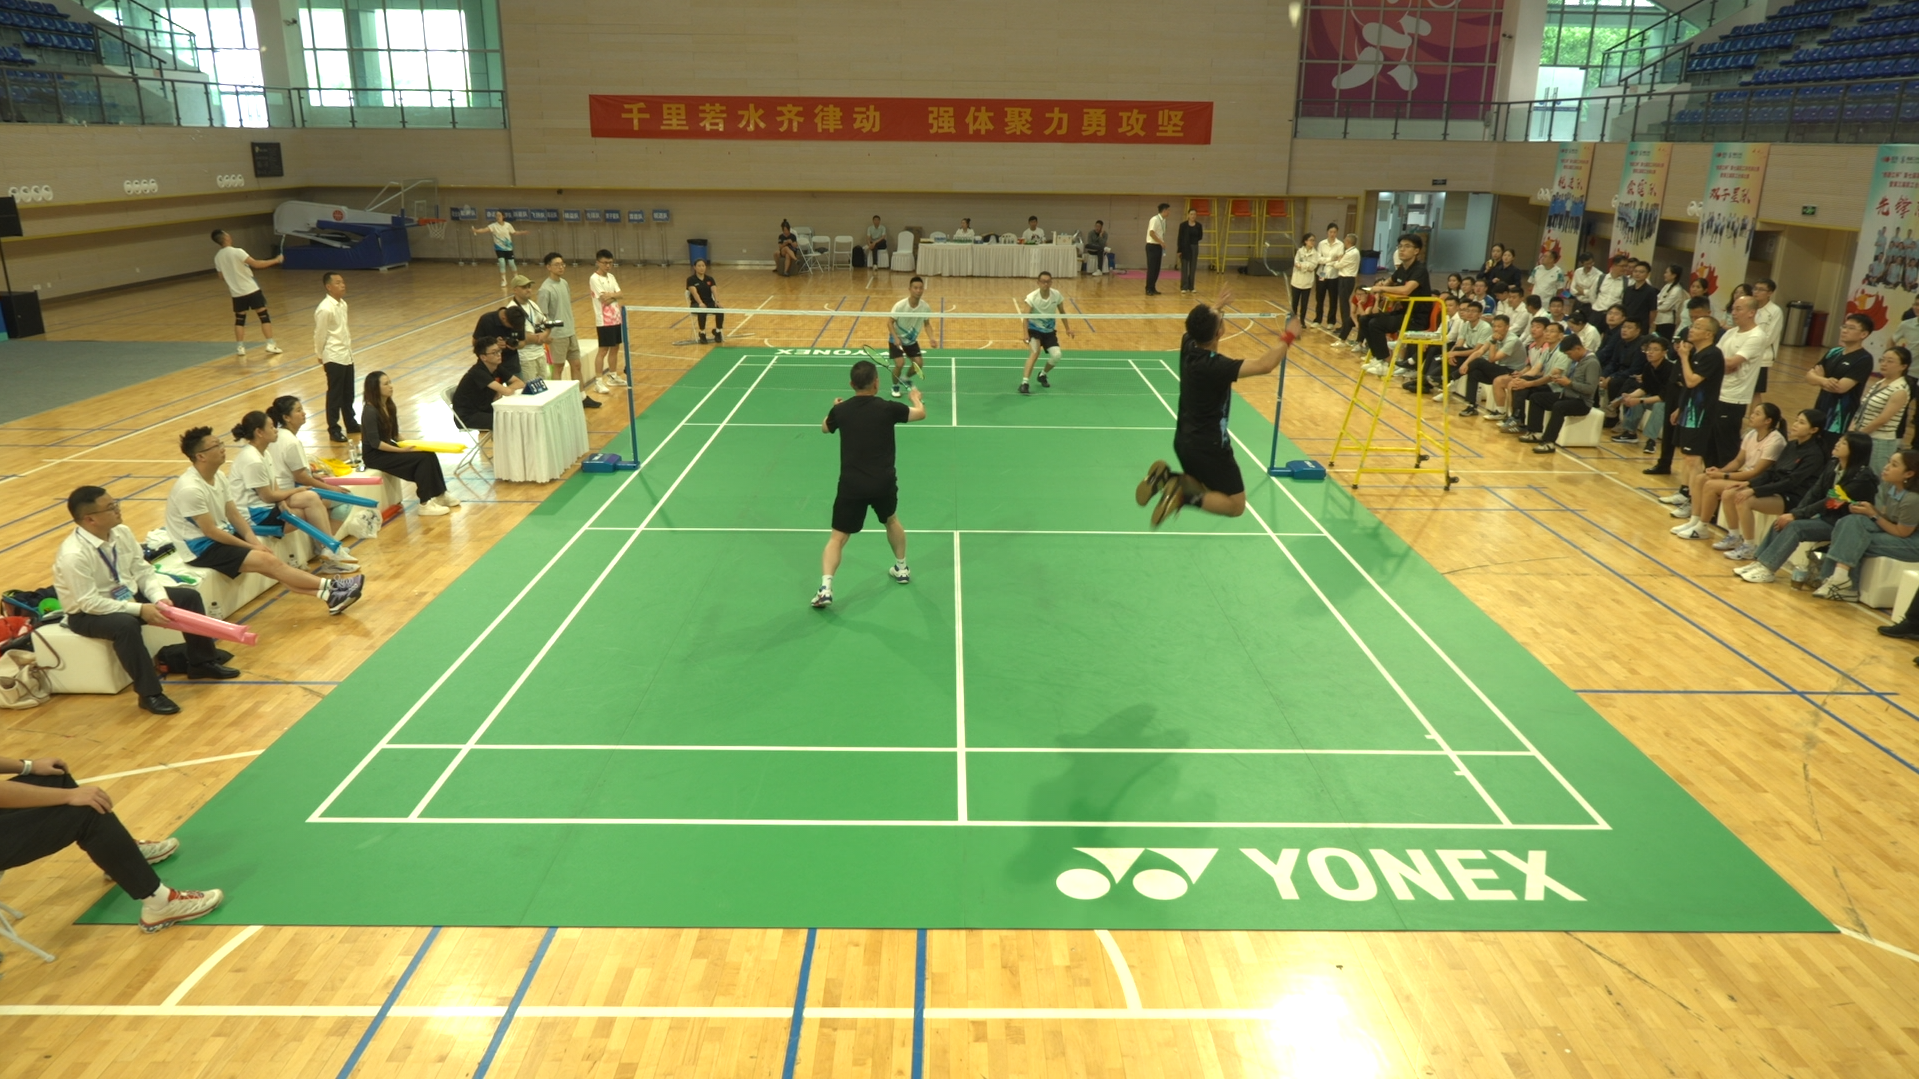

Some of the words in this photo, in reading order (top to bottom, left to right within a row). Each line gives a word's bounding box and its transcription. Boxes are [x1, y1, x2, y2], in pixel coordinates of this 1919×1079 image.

[621, 102, 881, 133] 千里若水齐律动
[927, 106, 1186, 137] 强体聚力勇攻坚
[1238, 847, 1588, 902] YONEX
